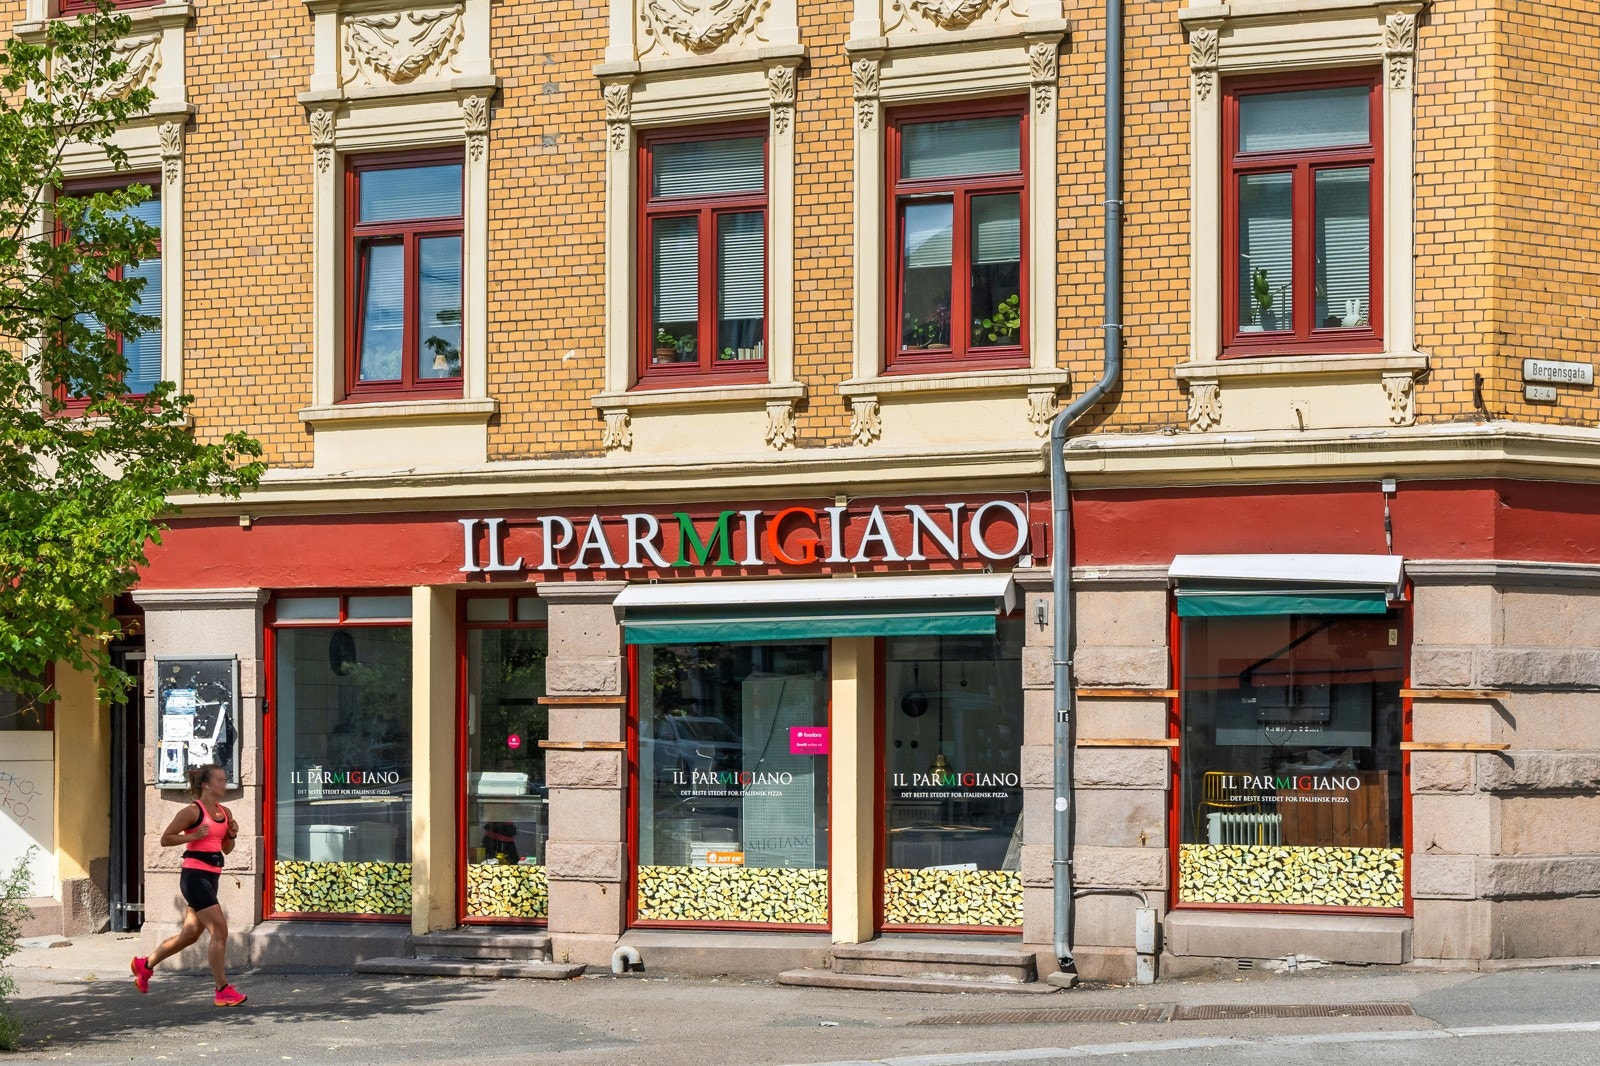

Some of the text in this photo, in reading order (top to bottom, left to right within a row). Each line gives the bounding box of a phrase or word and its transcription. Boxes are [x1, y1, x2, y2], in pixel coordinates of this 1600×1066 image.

[1532, 362, 1585, 381] Bergensgata
[458, 500, 1029, 572] IL PARMIGIANO
[290, 771, 399, 784] IL PARMIGIANO
[673, 771, 792, 784] IL PARMIGIANO
[893, 773, 1018, 786] IL PARMIGIANO
[1222, 776, 1360, 790] IL PARMIGIANO
